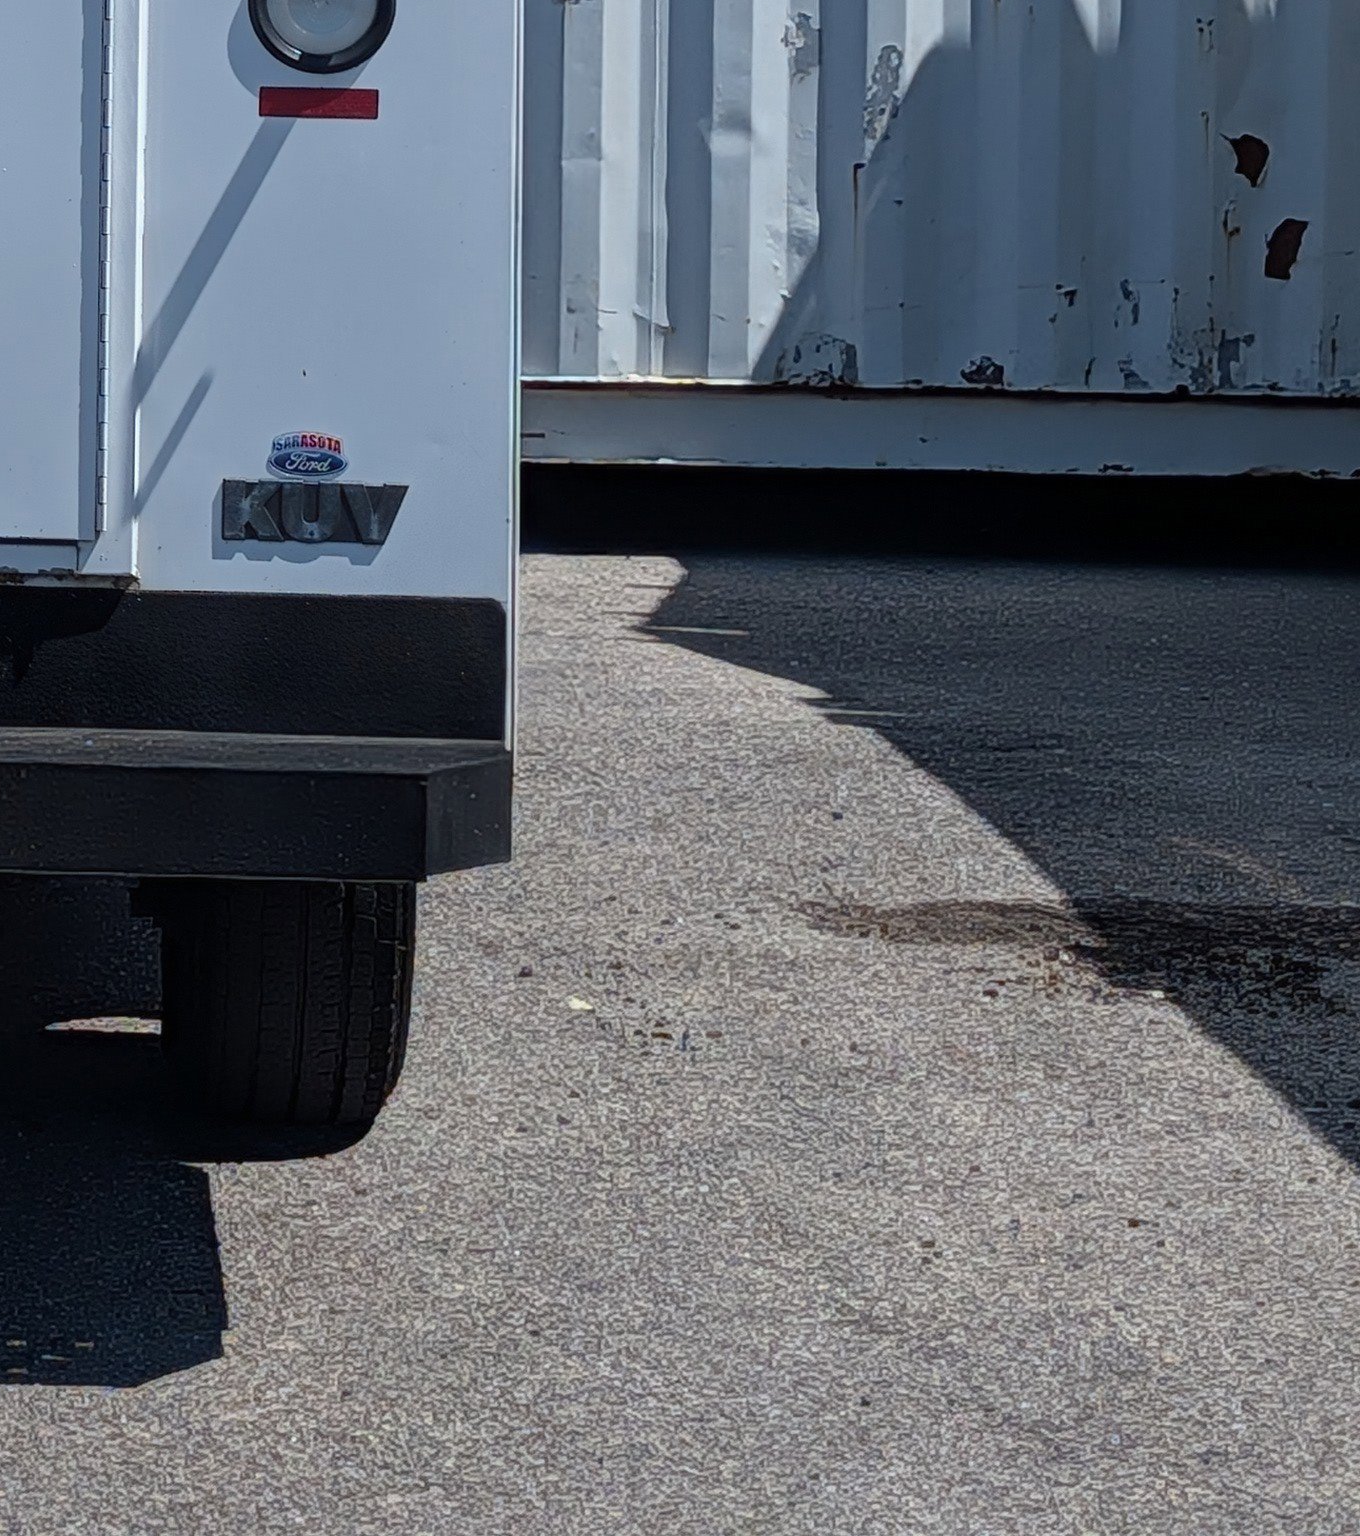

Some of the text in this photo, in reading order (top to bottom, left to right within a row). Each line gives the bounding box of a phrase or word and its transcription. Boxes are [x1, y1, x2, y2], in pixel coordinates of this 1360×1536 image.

[273, 434, 342, 454] SARASOTA
[285, 451, 332, 473] Ford
[221, 478, 410, 546] KUV
